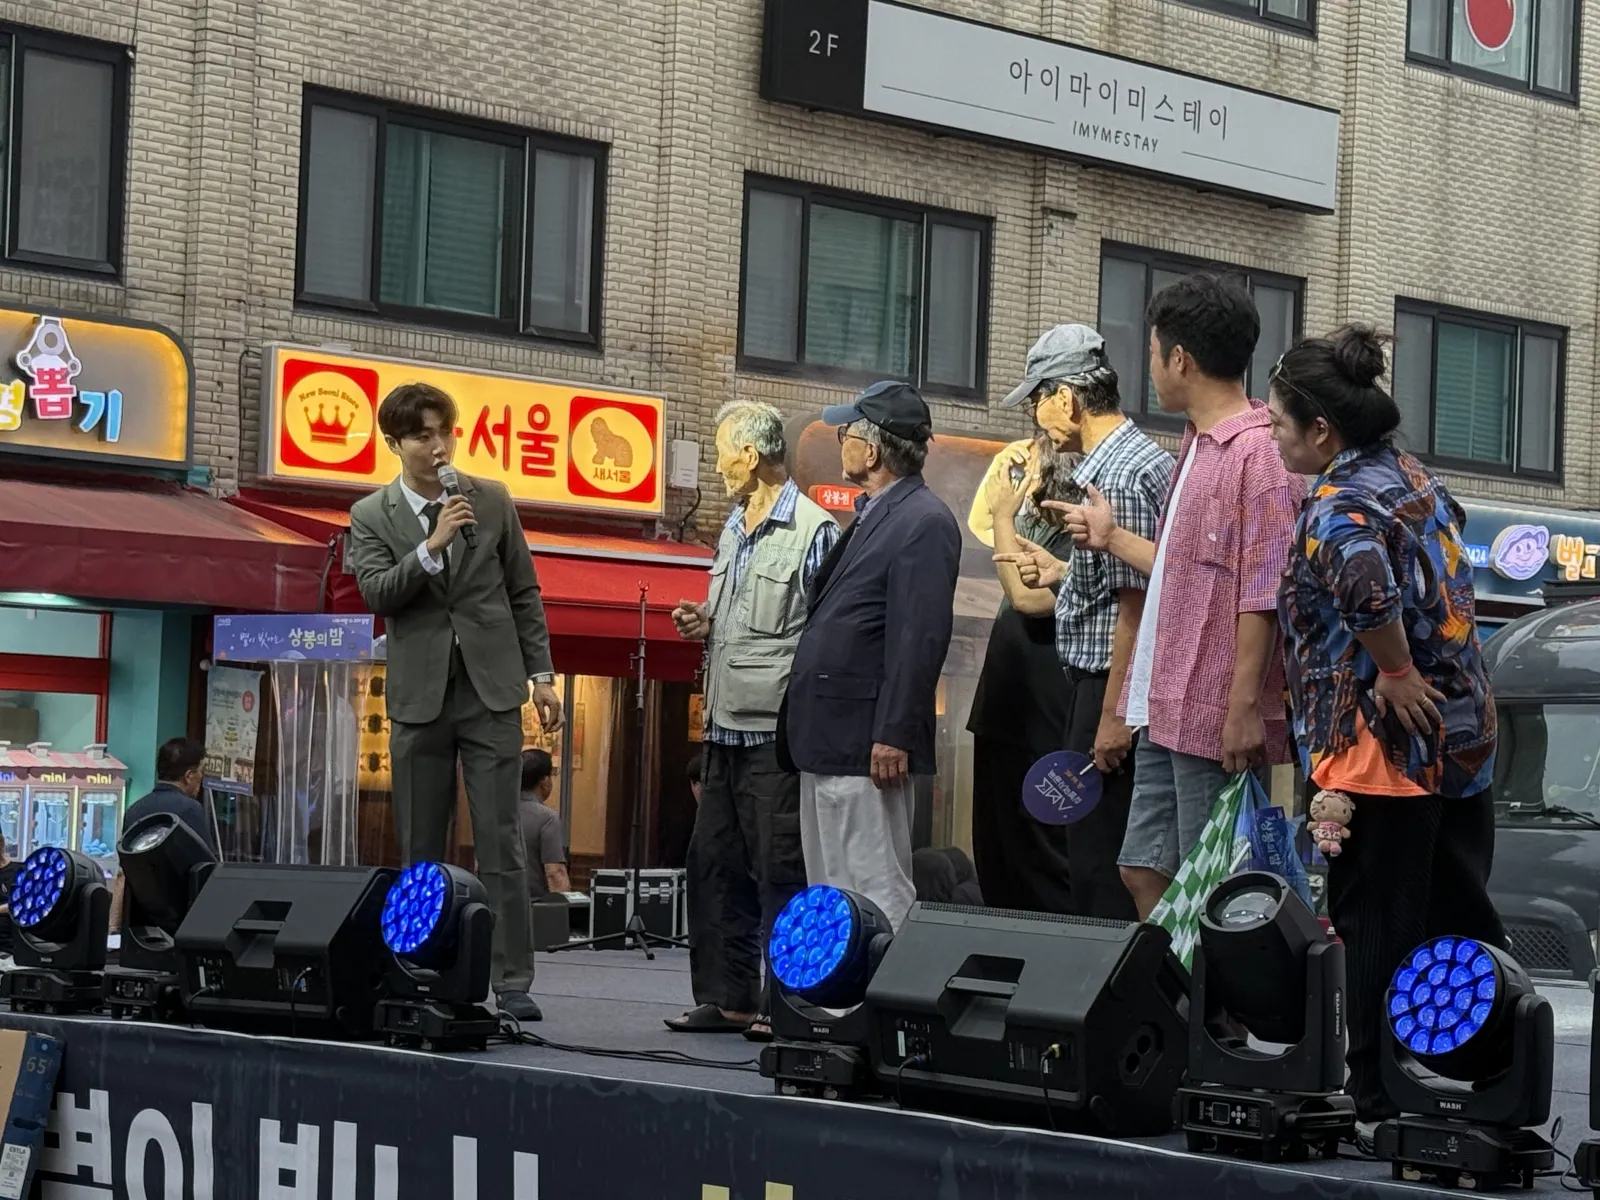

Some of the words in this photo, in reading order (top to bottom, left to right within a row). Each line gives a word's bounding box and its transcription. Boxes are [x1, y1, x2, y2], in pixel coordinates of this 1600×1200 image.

[808, 29, 840, 57] 2F
[1008, 57, 1229, 141] 아이마이미스테이
[1072, 120, 1160, 154] IMYMESTAY
[453, 404, 560, 478] 서울
[592, 466, 632, 484] 새서울
[288, 627, 328, 650] 상봉의
[329, 626, 345, 647] 밤
[40, 772, 67, 784] mini
[86, 773, 112, 785] mini
[1439, 1101, 1462, 1111] WASH
